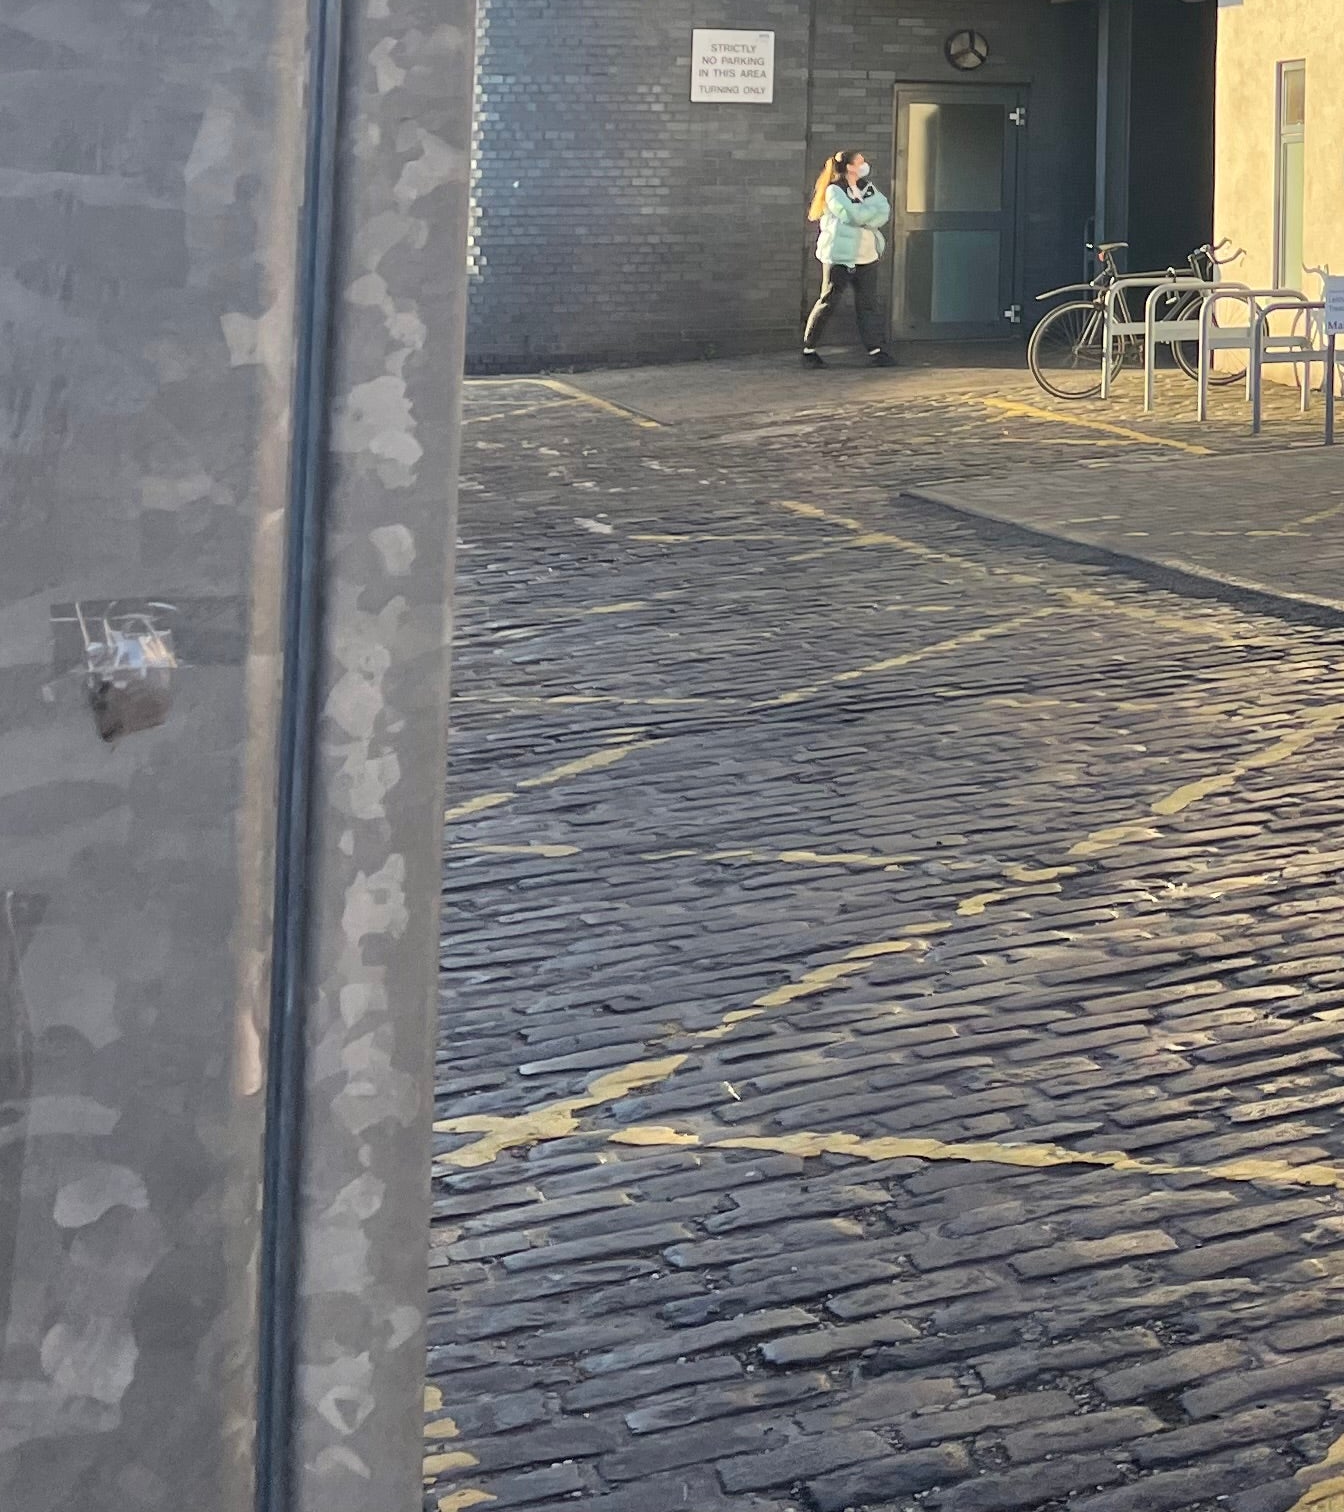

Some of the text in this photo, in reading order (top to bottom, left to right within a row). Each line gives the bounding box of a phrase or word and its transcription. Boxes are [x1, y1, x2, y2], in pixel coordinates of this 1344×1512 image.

[711, 44, 757, 53] STRICTLY
[702, 56, 764, 65] NO PARKING
[699, 69, 767, 79] IN THIS AREA
[699, 85, 766, 95] TURNING ONLY
